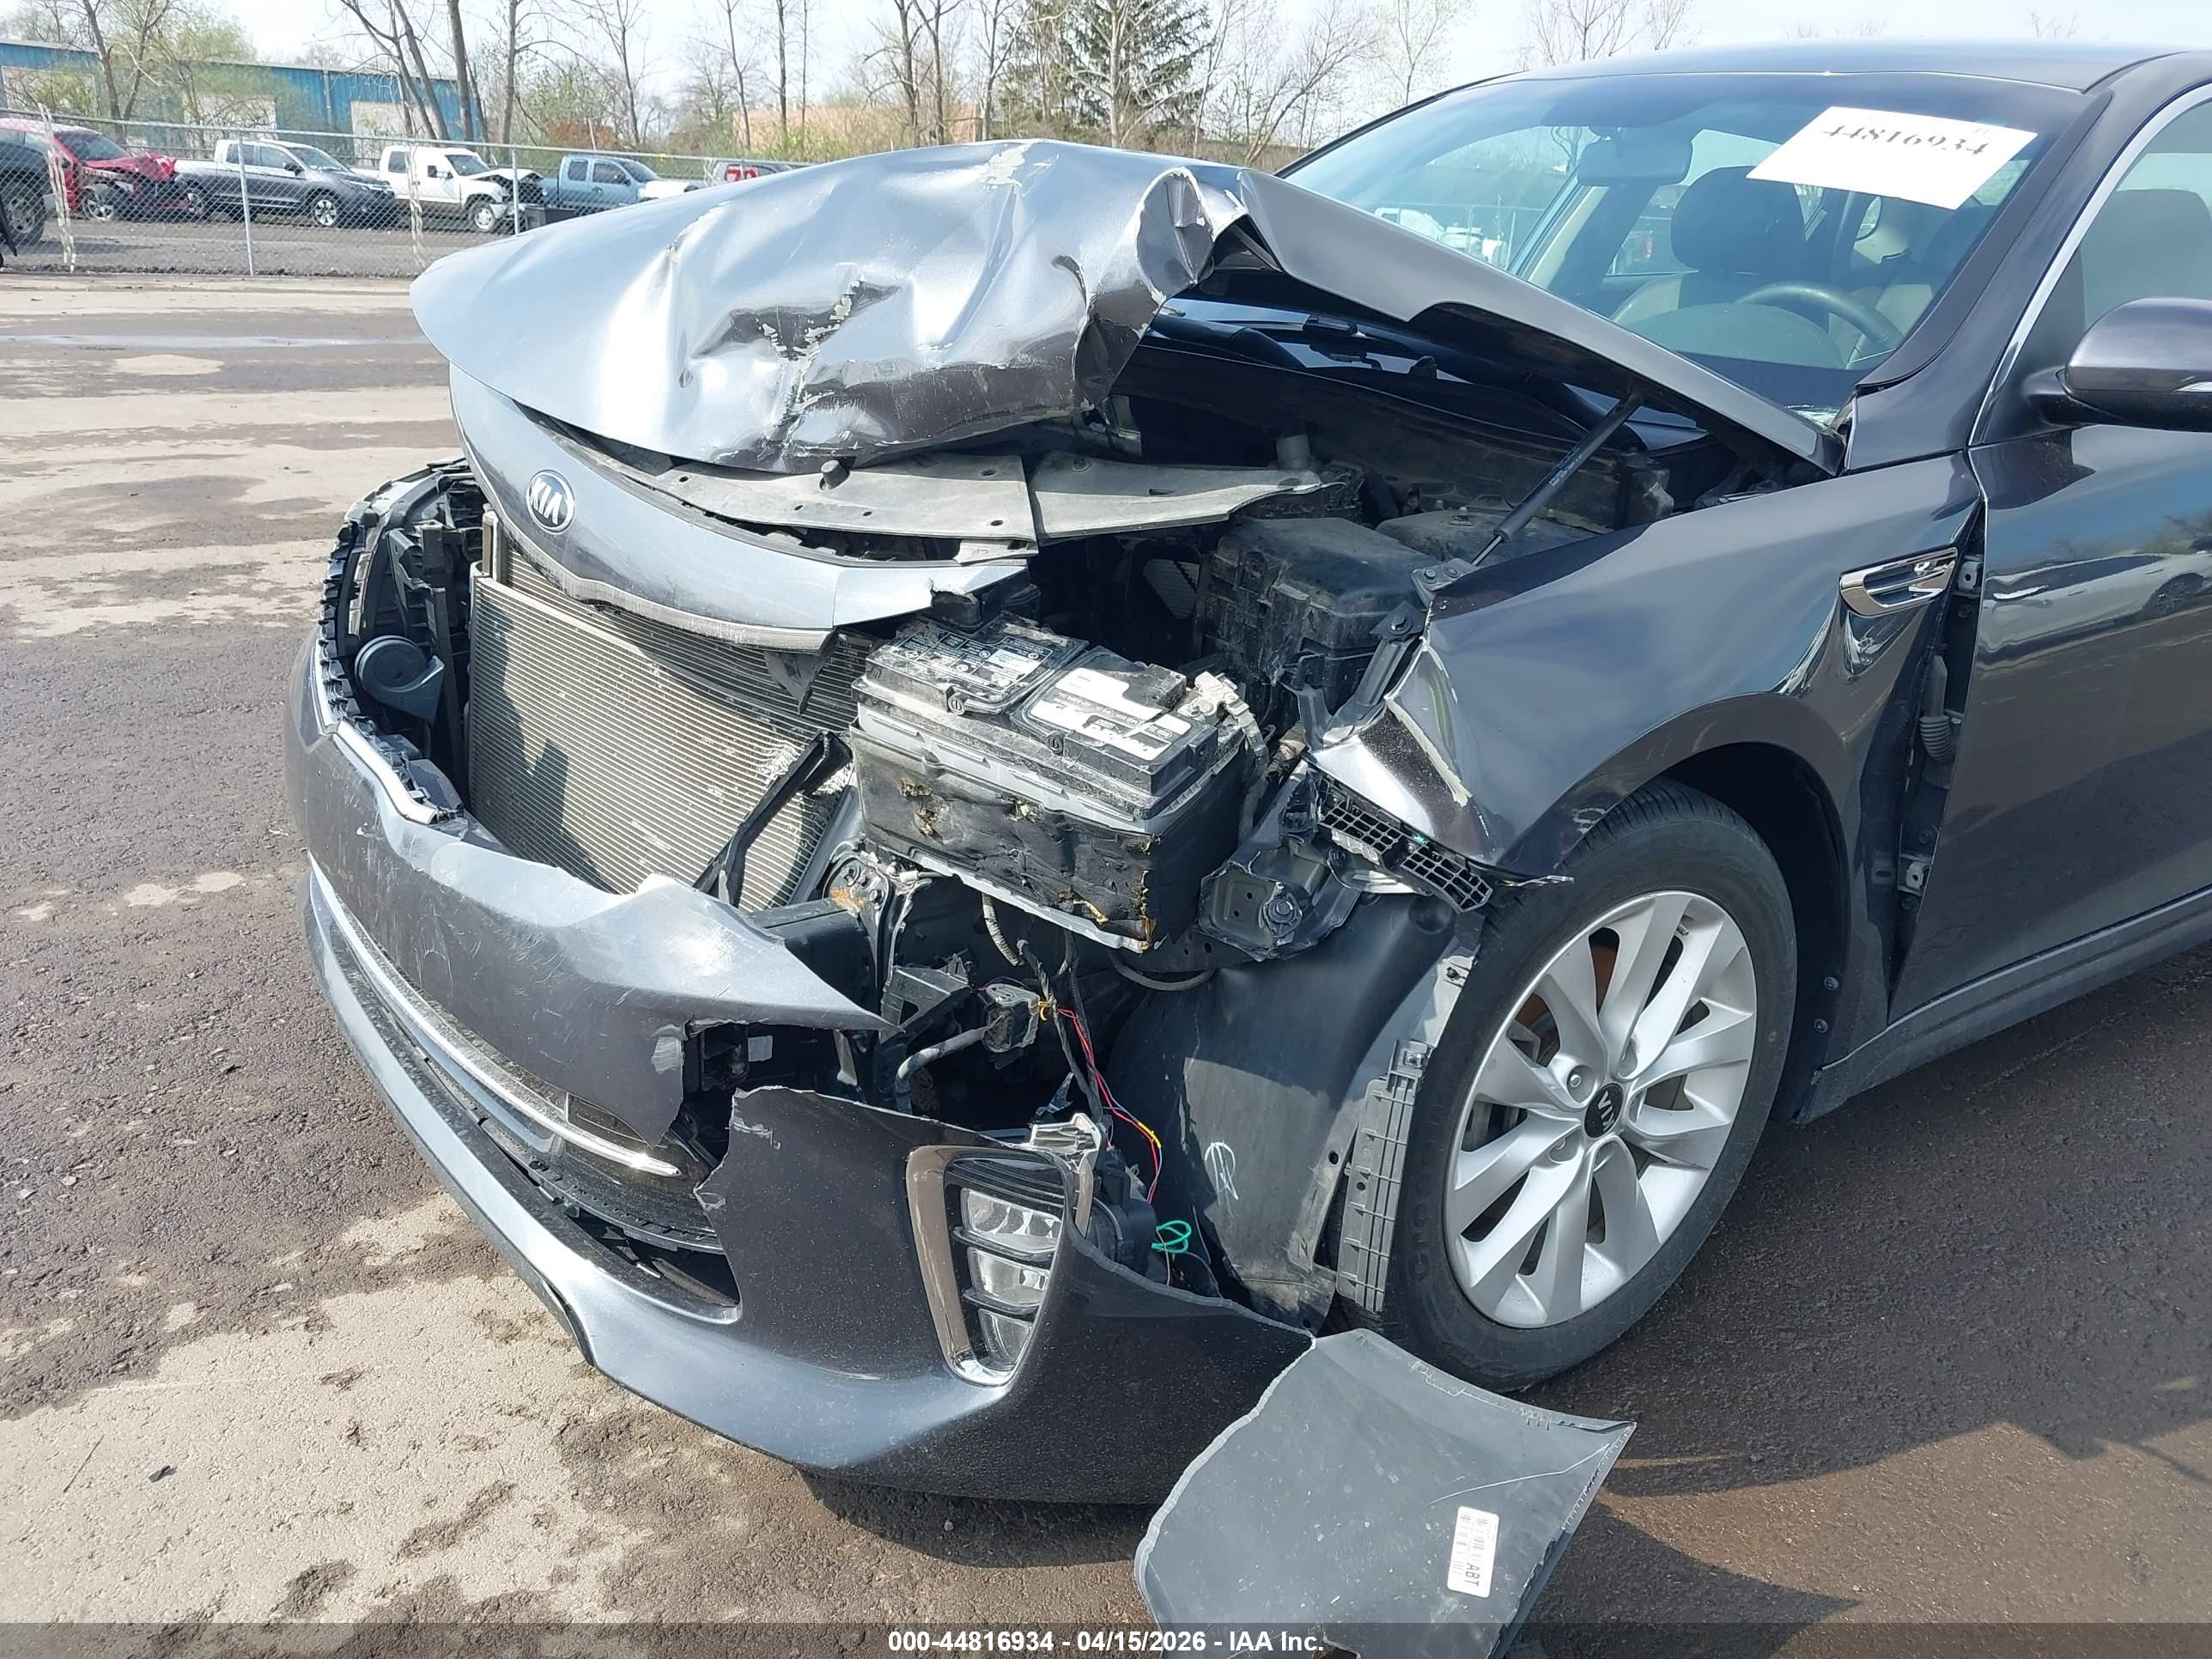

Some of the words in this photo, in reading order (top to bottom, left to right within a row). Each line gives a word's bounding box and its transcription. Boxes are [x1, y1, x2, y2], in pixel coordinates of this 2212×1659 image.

[1823, 125, 1989, 155] 44816934
[531, 477, 562, 525] KIA
[1597, 1090, 1615, 1133] KIA
[1464, 1562, 1480, 1587] ABT
